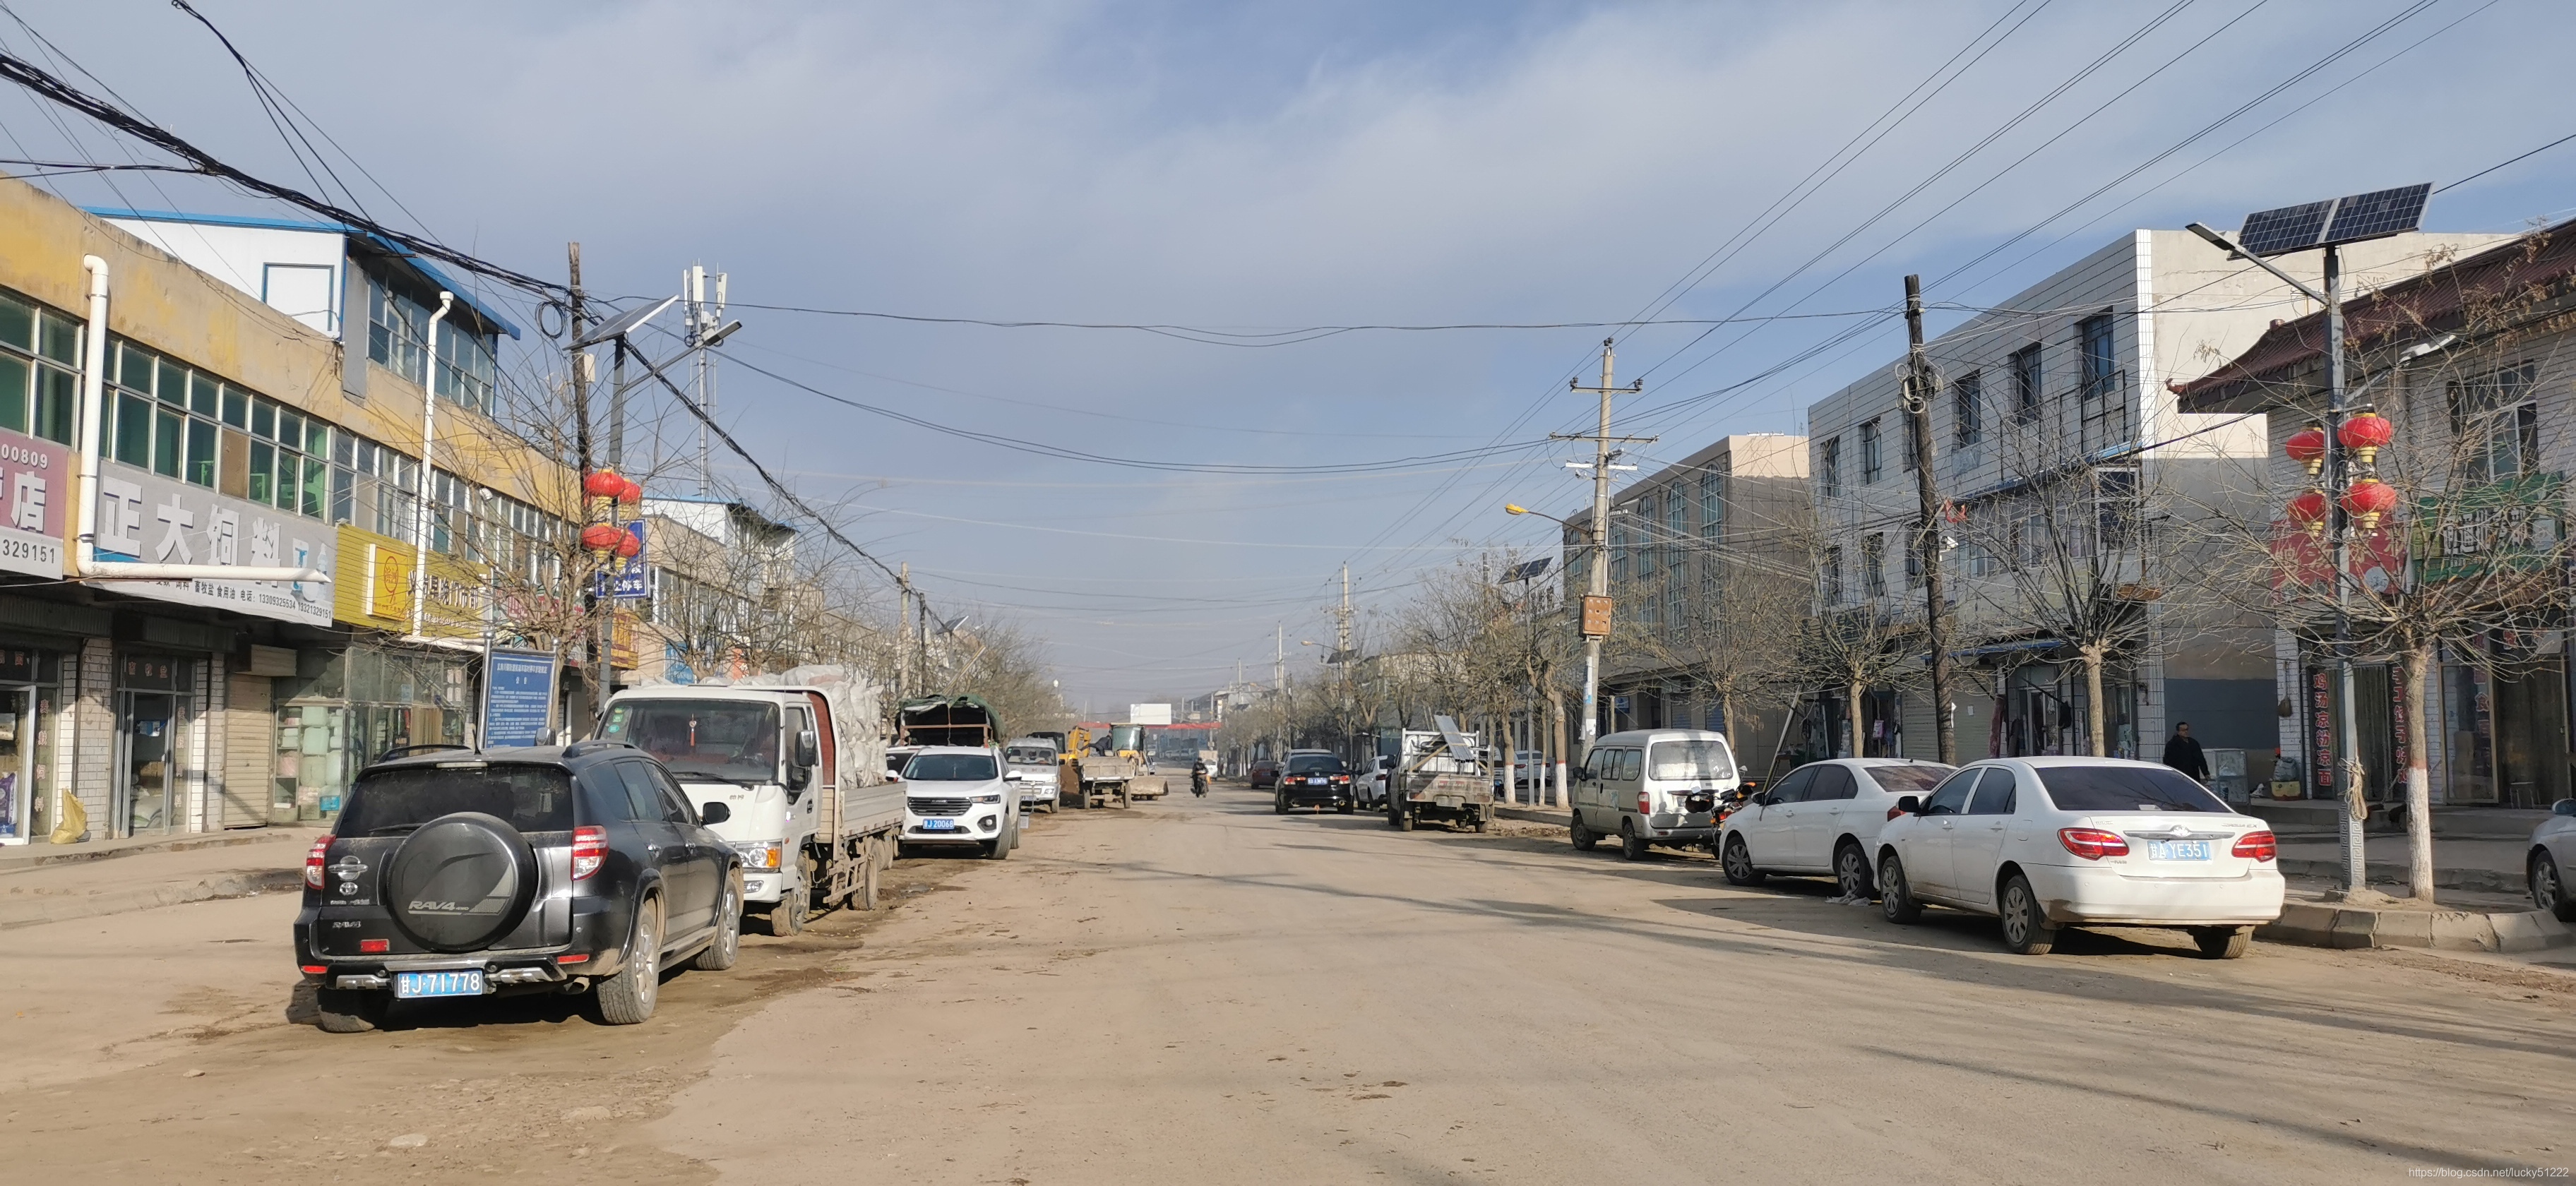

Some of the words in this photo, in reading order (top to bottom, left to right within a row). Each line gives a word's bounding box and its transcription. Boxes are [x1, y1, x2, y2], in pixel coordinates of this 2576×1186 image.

[0, 466, 46, 534] 店
[100, 476, 281, 588] 正大饲料
[2, 539, 55, 563] 329151
[217, 585, 236, 600] 食用油
[258, 594, 296, 609] 13309325534
[297, 601, 331, 620] 13321329151
[408, 901, 455, 911] RAV4
